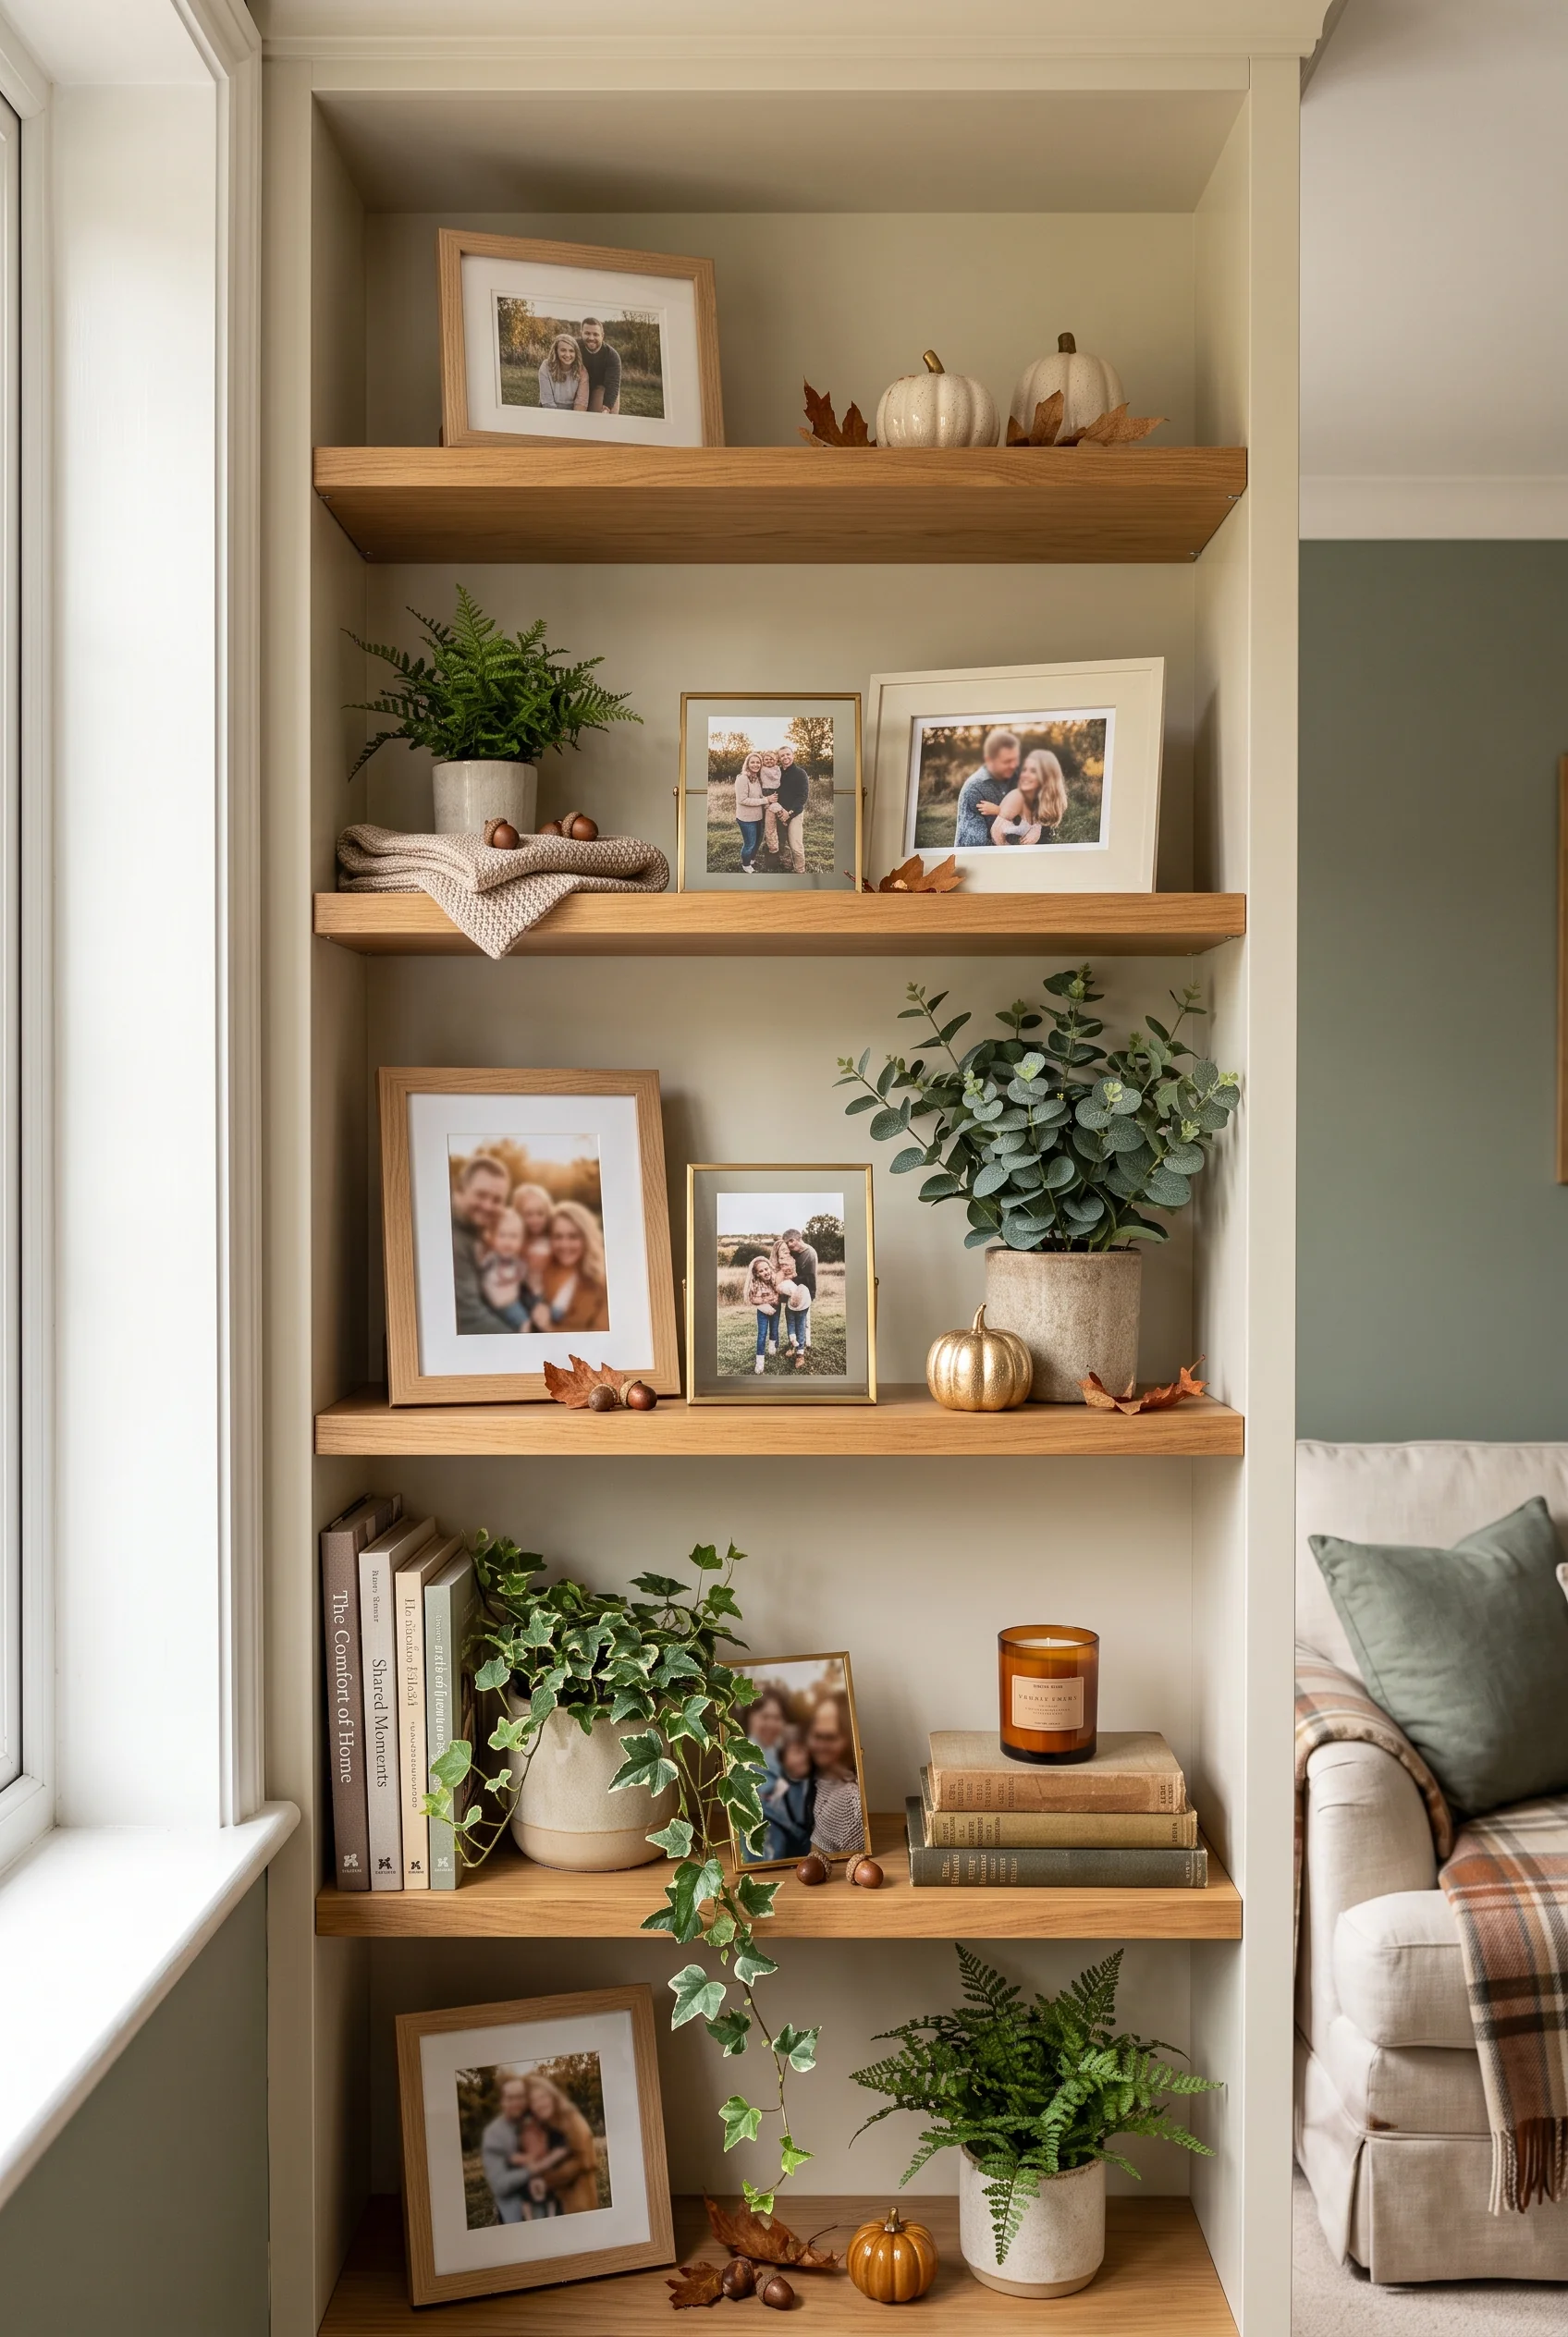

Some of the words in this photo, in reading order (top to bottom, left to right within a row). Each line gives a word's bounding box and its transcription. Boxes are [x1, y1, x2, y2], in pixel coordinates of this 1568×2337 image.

[333, 1590, 349, 1624] The
[334, 1630, 352, 1703] Comfort
[372, 1658, 388, 1710] Shared
[337, 1707, 354, 1727] of
[338, 1731, 354, 1783] Home
[374, 1716, 388, 1788] Moments
